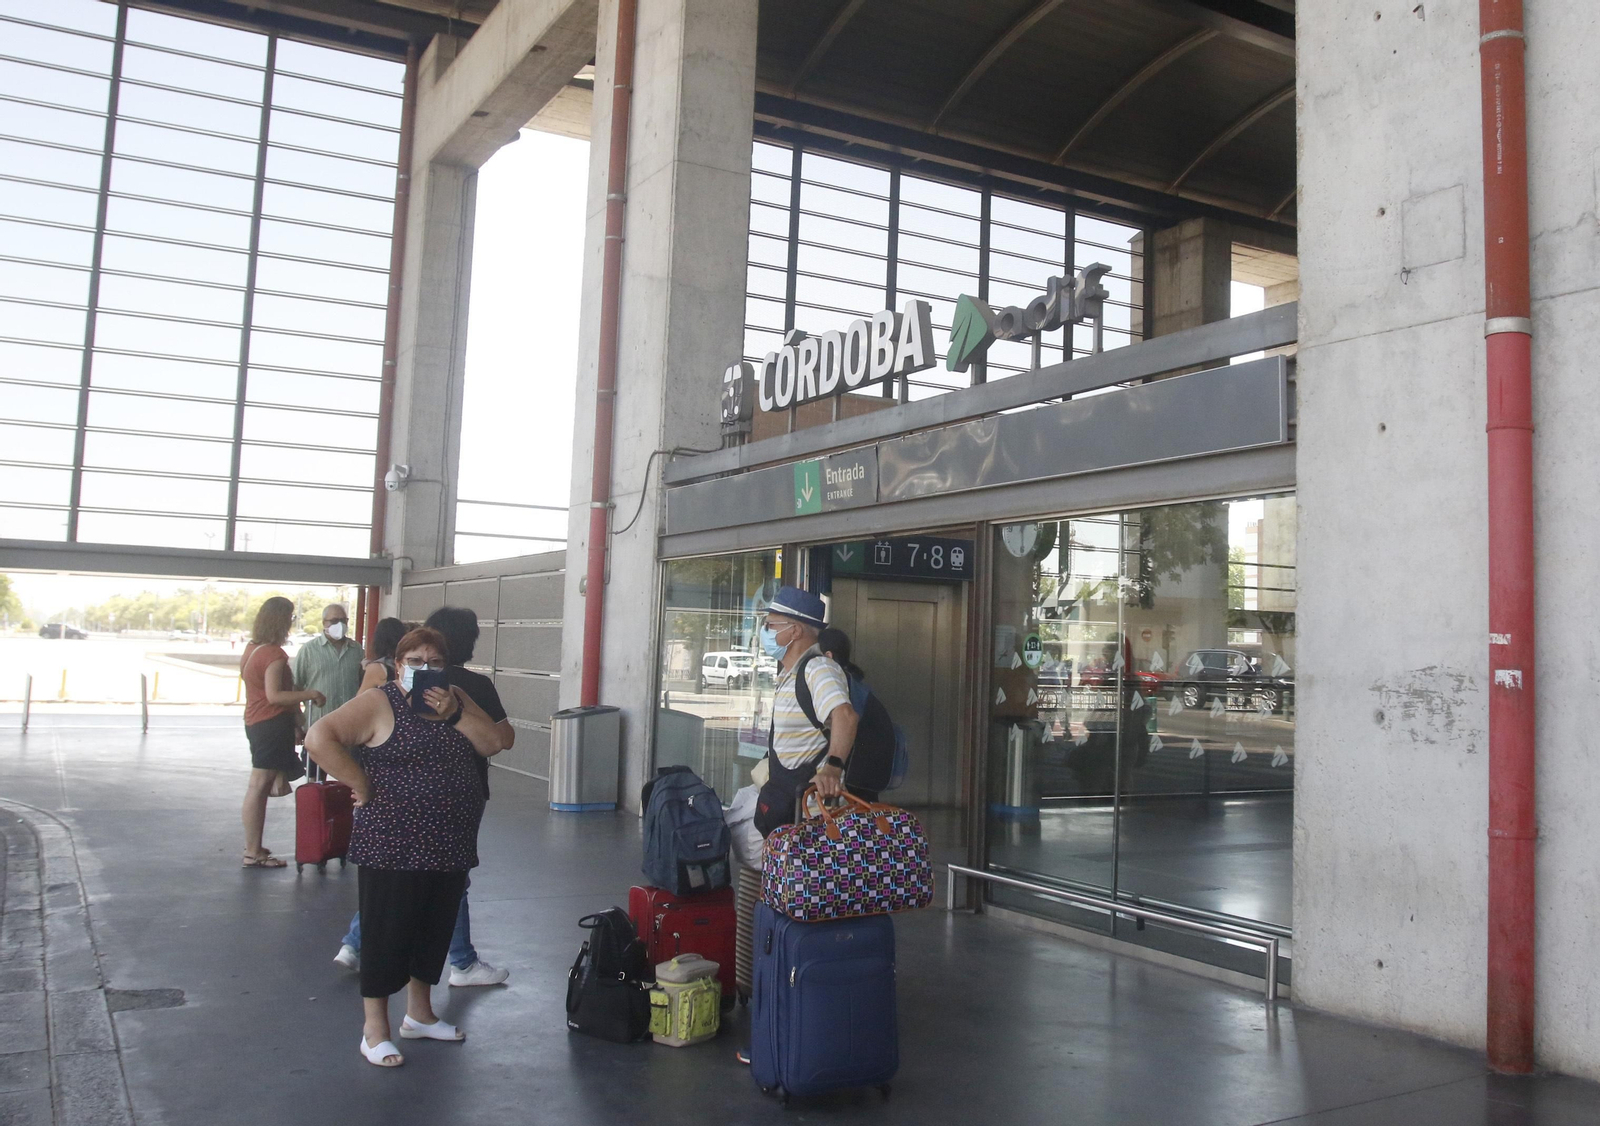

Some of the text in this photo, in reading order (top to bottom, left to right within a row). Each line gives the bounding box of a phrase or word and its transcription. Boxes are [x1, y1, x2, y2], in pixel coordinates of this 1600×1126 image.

[993, 262, 1112, 340] adif
[759, 299, 930, 412] CÓRDOBA
[826, 462, 865, 485] Entrada
[827, 488, 854, 501] ENTRANCE
